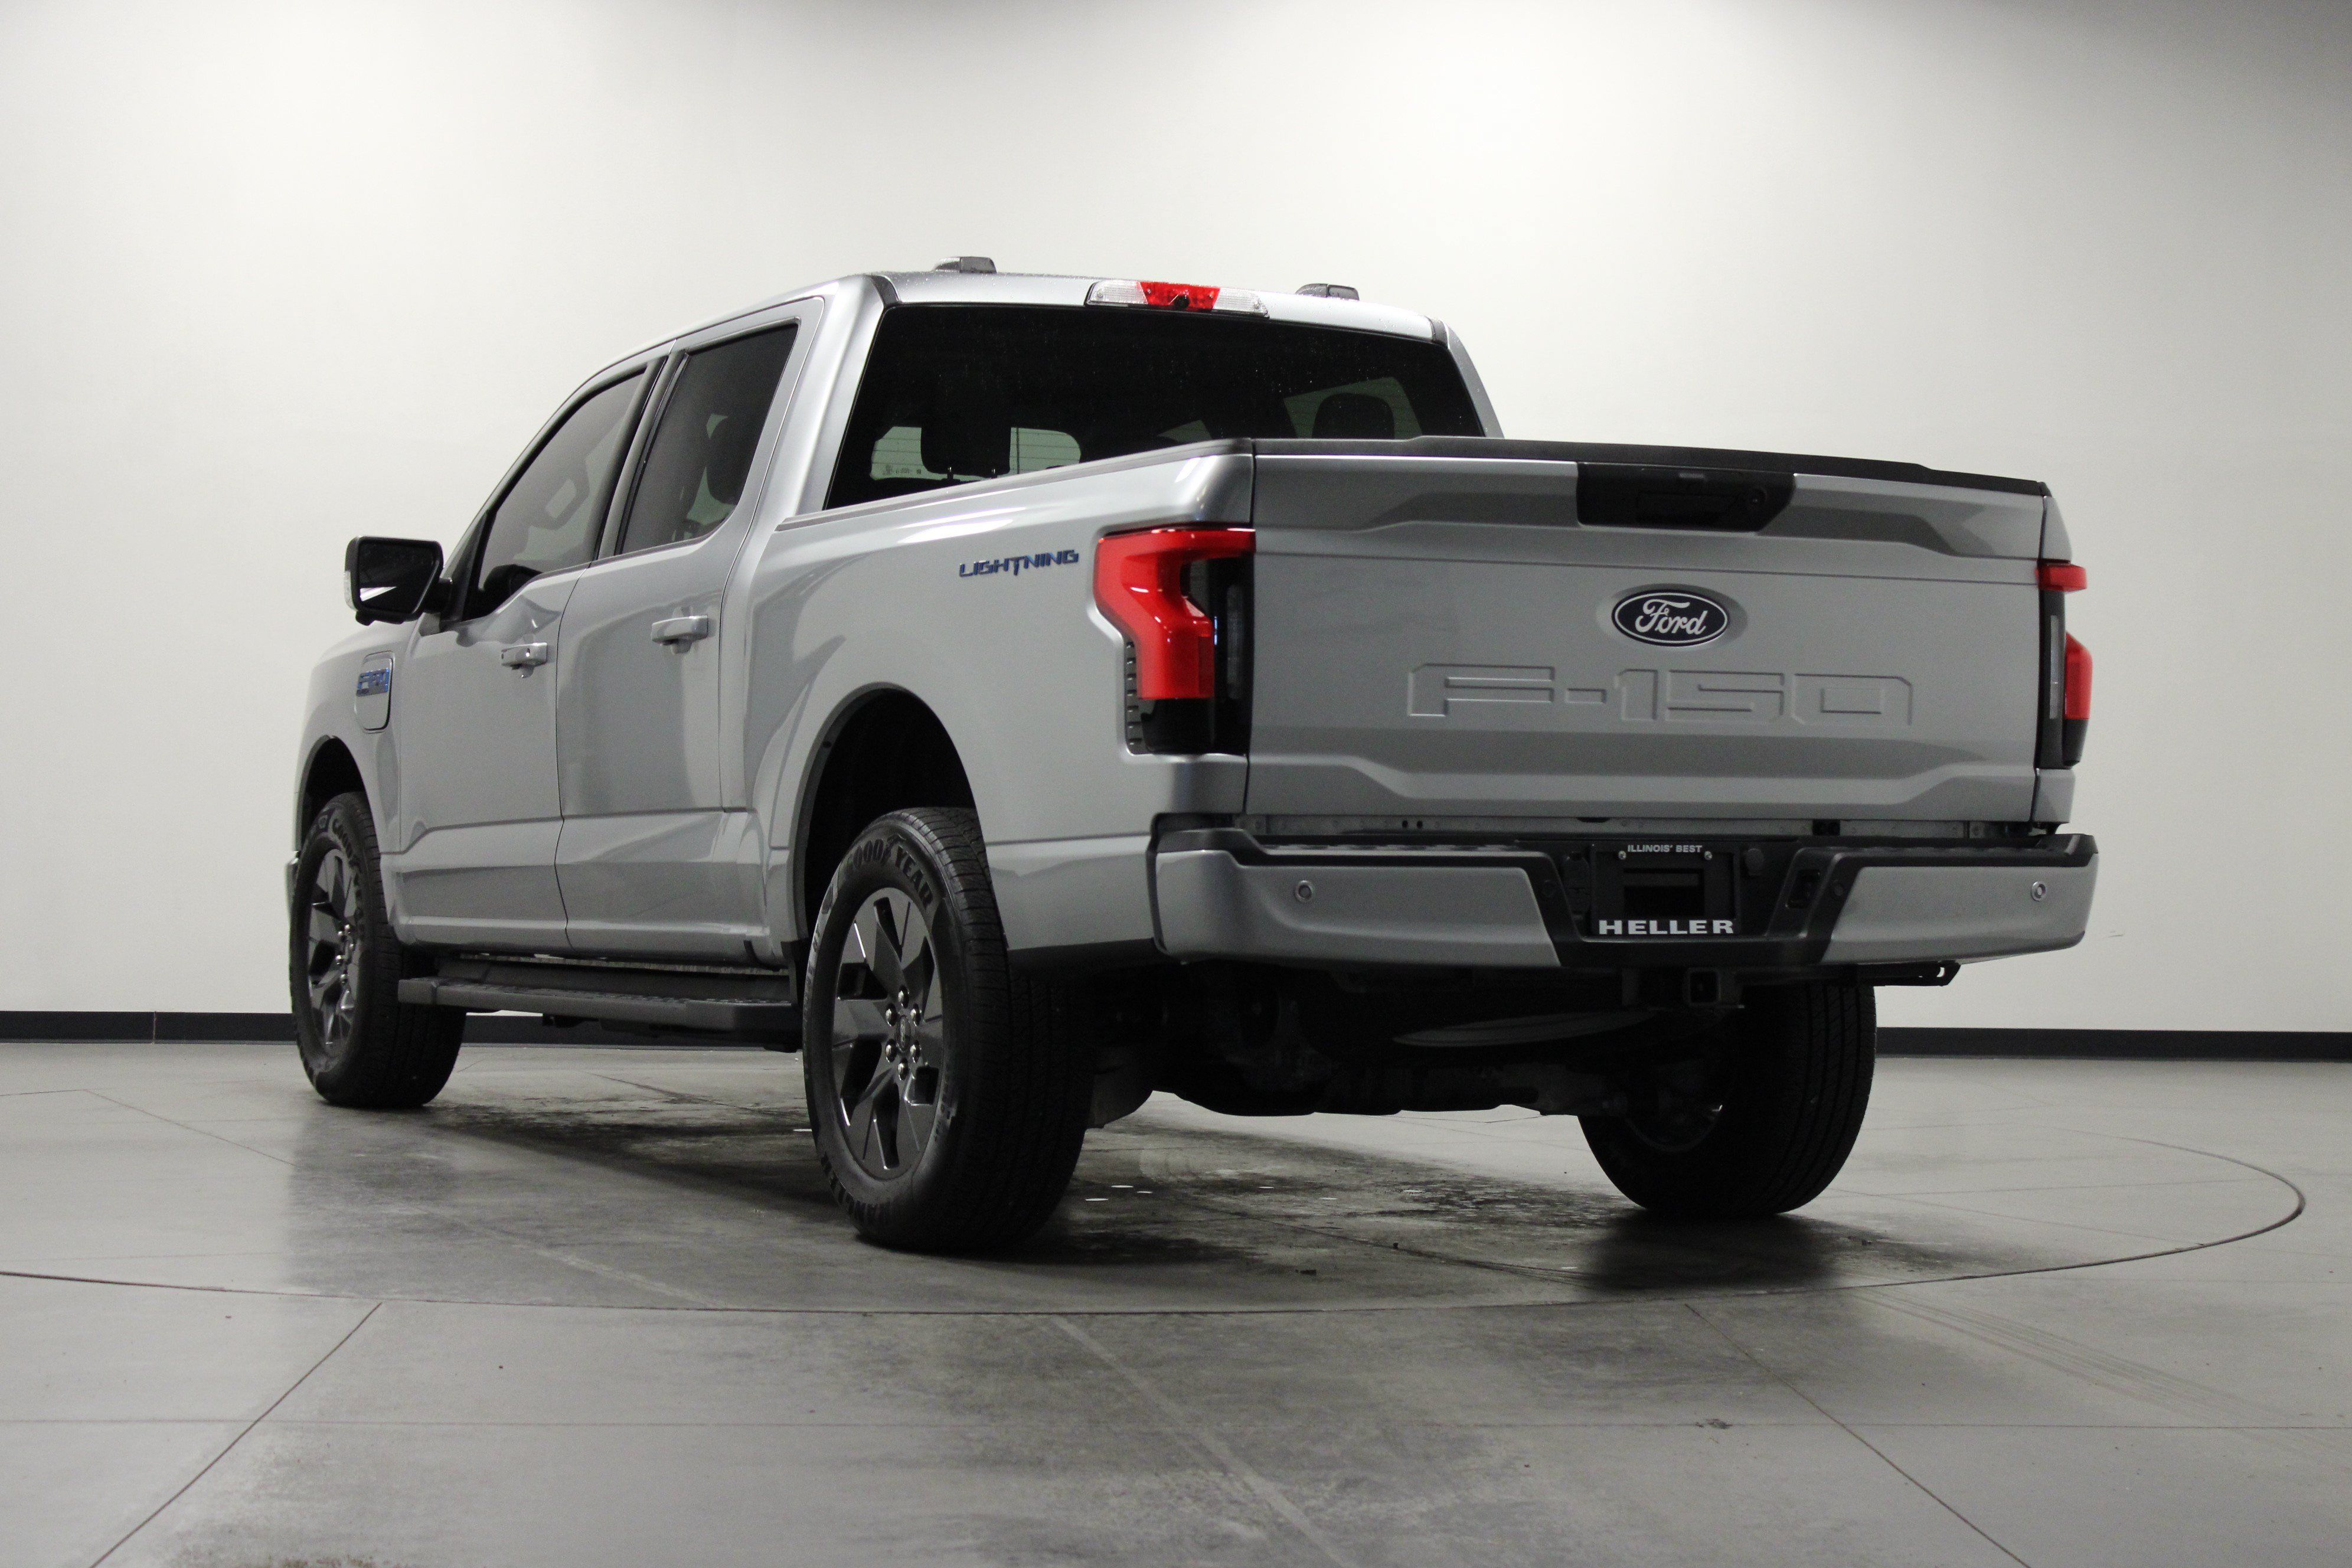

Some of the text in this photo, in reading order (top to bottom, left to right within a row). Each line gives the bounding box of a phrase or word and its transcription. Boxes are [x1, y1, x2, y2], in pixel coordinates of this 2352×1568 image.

[959, 550, 1079, 577] LIGHTNING
[1635, 598, 1709, 635] Ford
[1408, 662, 1913, 727] F-150
[1675, 844, 1703, 853] BEST
[1598, 919, 1734, 935] HELLER
